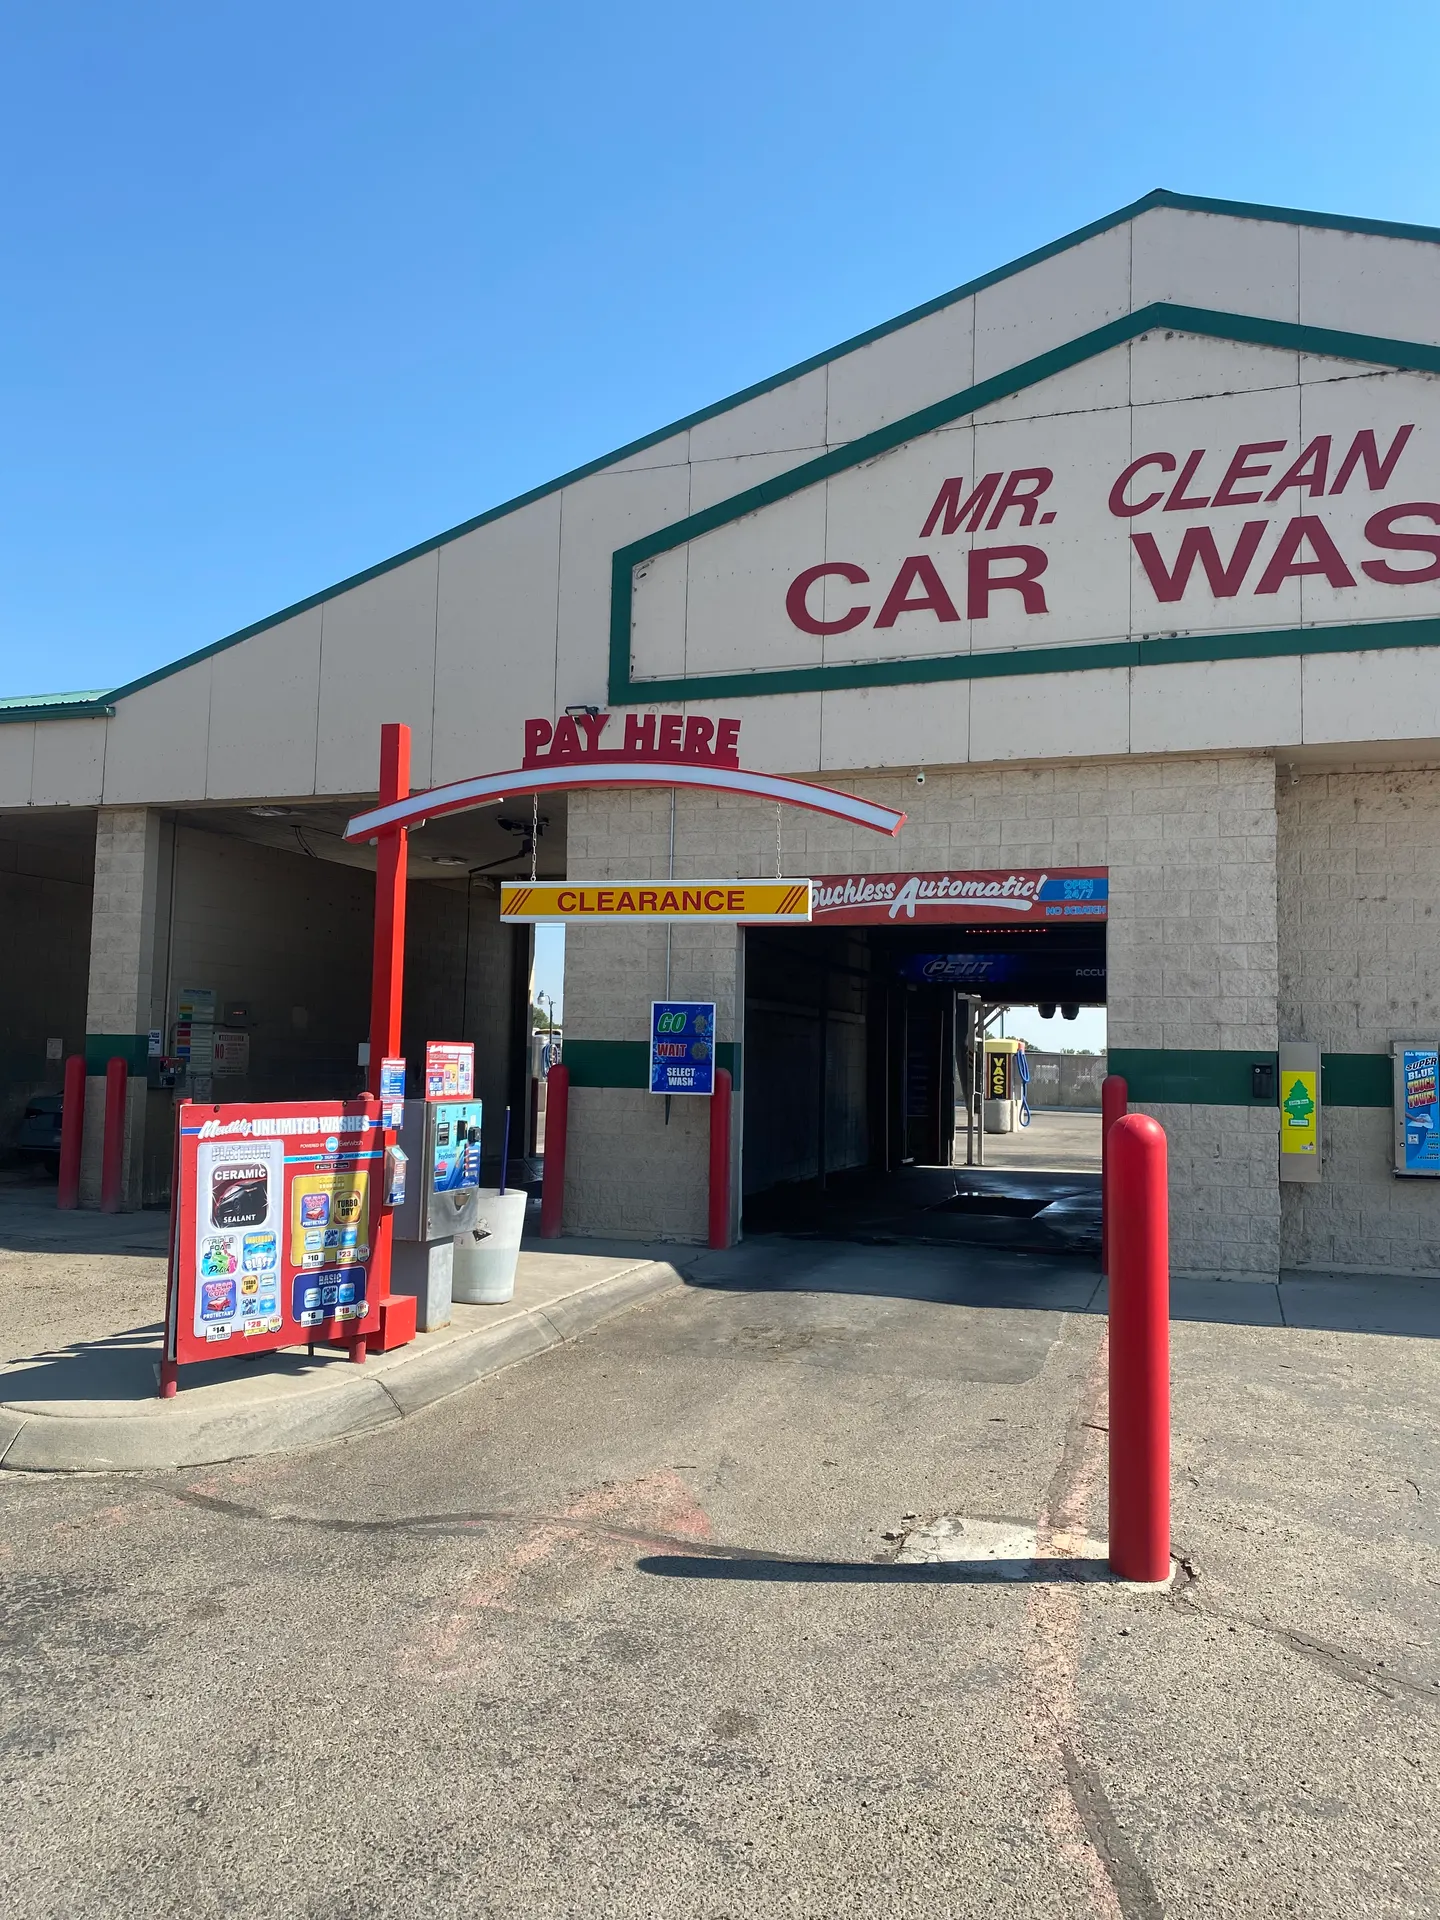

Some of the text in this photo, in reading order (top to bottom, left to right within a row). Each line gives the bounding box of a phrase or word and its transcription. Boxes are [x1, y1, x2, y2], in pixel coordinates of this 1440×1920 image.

[919, 424, 1415, 538] MR. CLEAN
[785, 502, 1440, 636] CAR WAS
[525, 713, 742, 757] PAY HERE
[1063, 879, 1094, 890] OPEN
[888, 874, 1048, 919] Automatic!
[1063, 889, 1094, 899] 24/7
[557, 890, 746, 913] CLEARANCE
[1046, 905, 1107, 916] NO SCRATCH
[926, 960, 994, 974] PETIT
[1075, 968, 1106, 977] ACCU
[657, 1012, 687, 1033] GO
[214, 1043, 224, 1059] NO
[657, 1043, 687, 1058] WAIT
[1405, 1057, 1438, 1071] SUPER
[666, 1067, 696, 1077] SELECT
[992, 1057, 1005, 1095] VACS
[1408, 1067, 1434, 1081] BLUE
[668, 1076, 694, 1086] WASH
[1407, 1076, 1436, 1095] TRUCK
[1407, 1090, 1437, 1109] TOWEL
[197, 1118, 252, 1139] Monthly
[252, 1117, 319, 1137] UNLIMITED
[319, 1115, 370, 1133] WASHES
[211, 1144, 271, 1161] PLATINUM
[214, 1168, 267, 1181] CERAMIC
[337, 1199, 358, 1208] TURBO
[223, 1214, 257, 1224] SEALANT
[341, 1208, 354, 1217] DRY
[339, 1250, 352, 1258] $23
[245, 1255, 274, 1269] BLAST
[318, 1273, 342, 1285] BASIC
[202, 1310, 234, 1319] PROTECTANT
[212, 1326, 225, 1334] $14
[247, 1320, 262, 1329] $28
